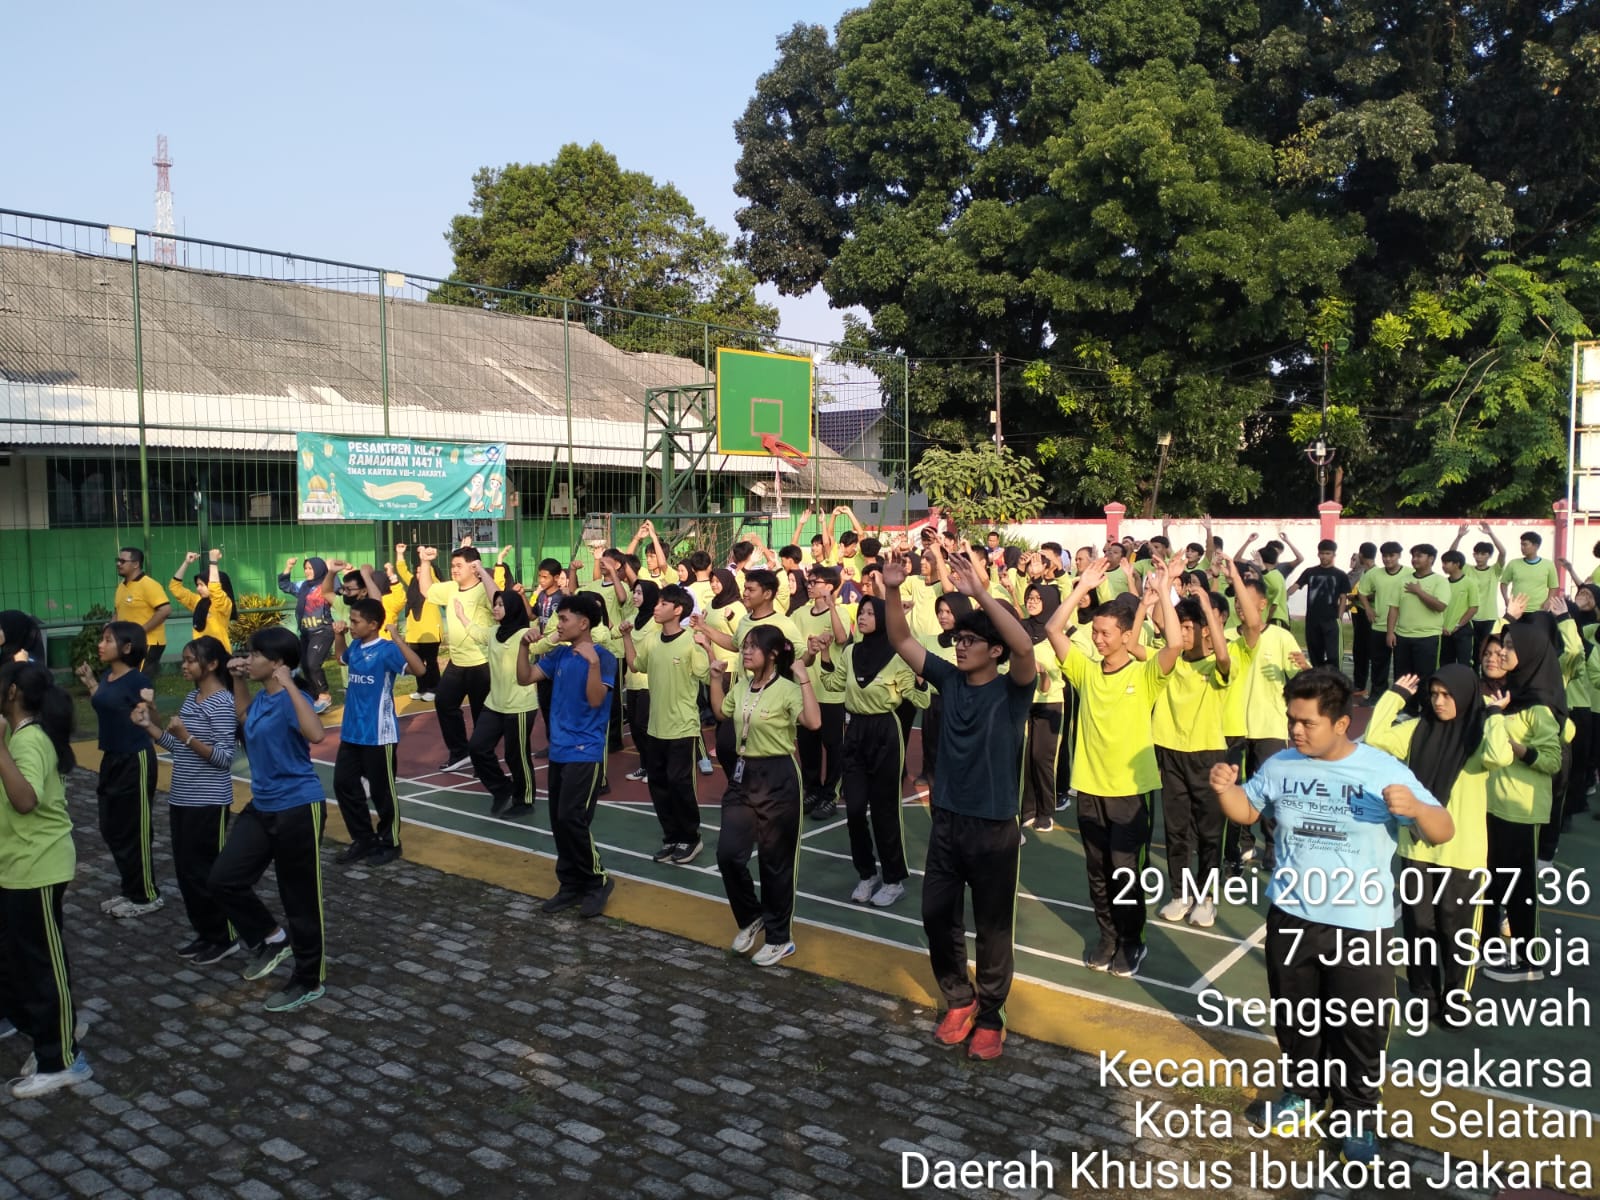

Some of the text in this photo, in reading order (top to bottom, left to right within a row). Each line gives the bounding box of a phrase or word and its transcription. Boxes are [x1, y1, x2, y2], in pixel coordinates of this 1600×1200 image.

[348, 441, 443, 457] PESANTREN KILAT
[348, 454, 443, 468] RAMADHAN 1447 H
[367, 468, 398, 477] KARTIKA
[417, 470, 447, 478] JAKARTA
[1282, 777, 1364, 805] LIVE IN
[1308, 801, 1318, 812] TO
[1322, 804, 1364, 816] CAMPUS
